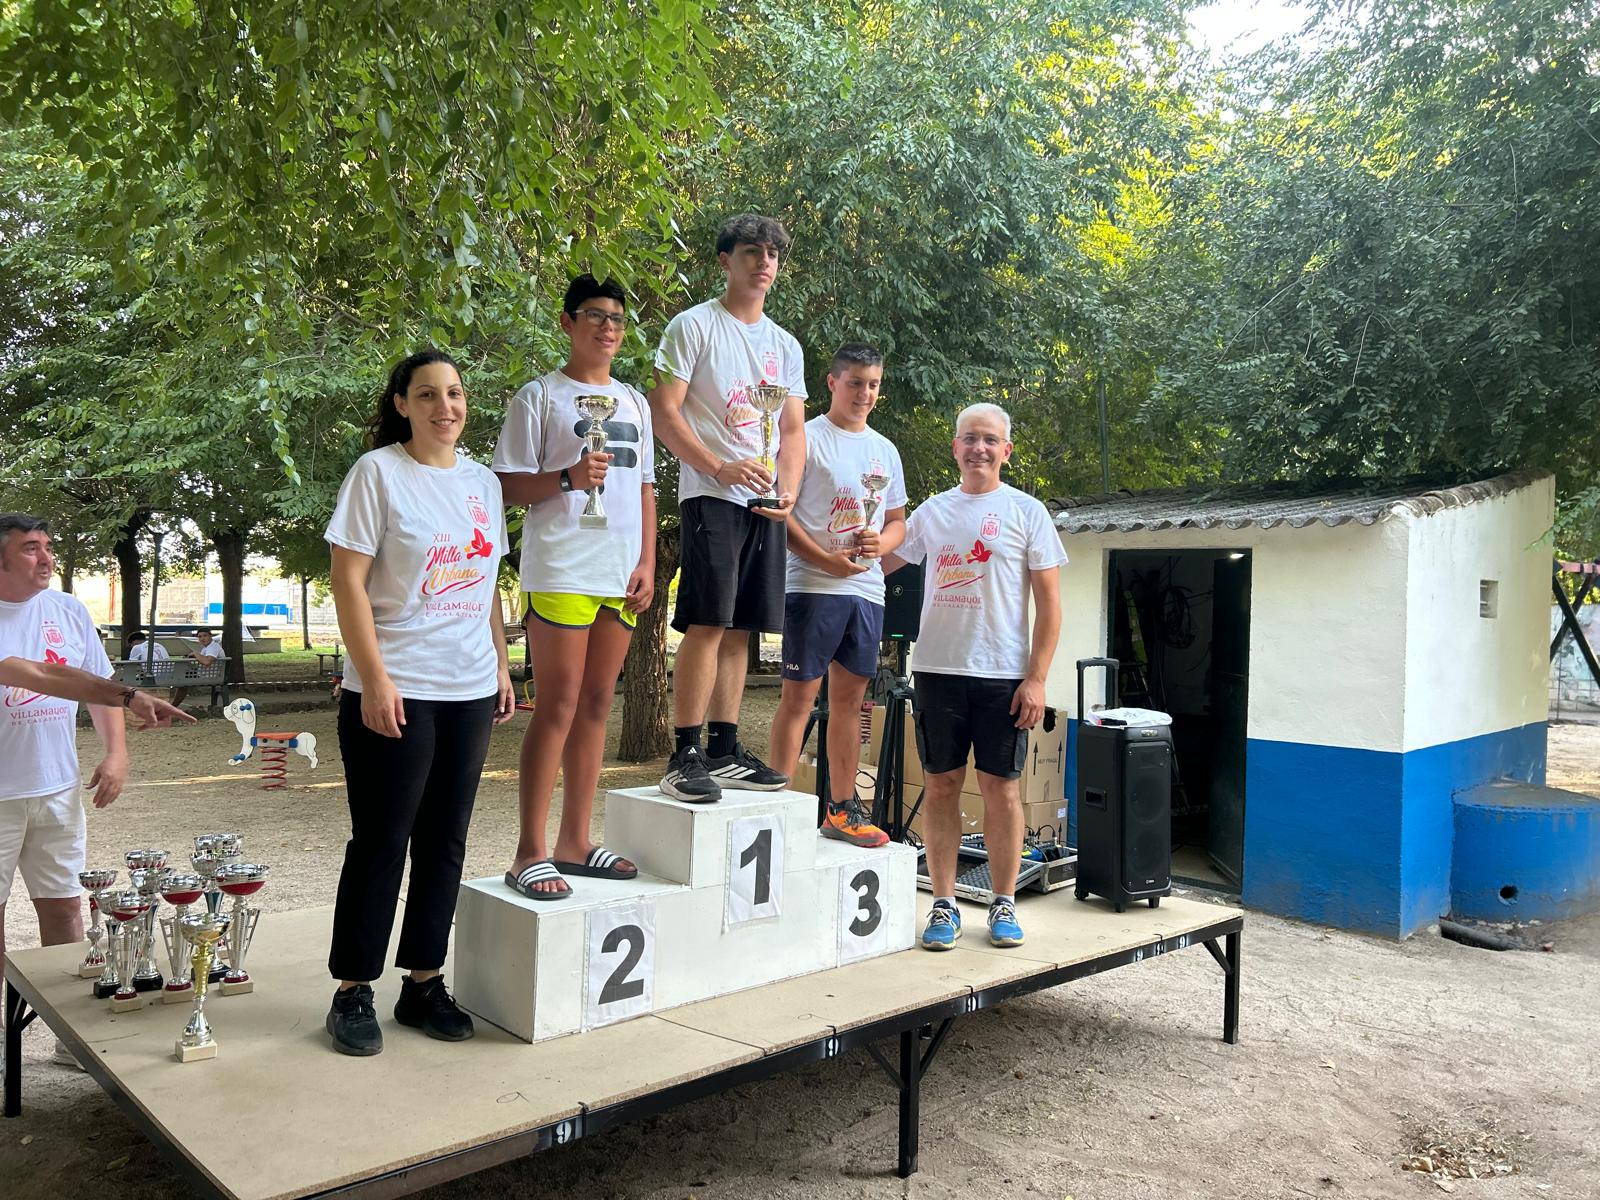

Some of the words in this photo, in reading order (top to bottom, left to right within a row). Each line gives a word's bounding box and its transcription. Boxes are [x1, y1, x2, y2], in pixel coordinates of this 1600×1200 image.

[837, 487, 851, 495] XIII
[830, 496, 860, 516] Milla
[433, 533, 451, 543] XIII
[426, 545, 462, 572] Milla
[936, 553, 962, 574] Milla
[430, 566, 478, 590] Urbana
[938, 569, 976, 585] Urbana
[786, 663, 800, 671] FILA
[740, 829, 772, 906] 1
[848, 868, 882, 937] 3
[598, 923, 645, 1006] 2
